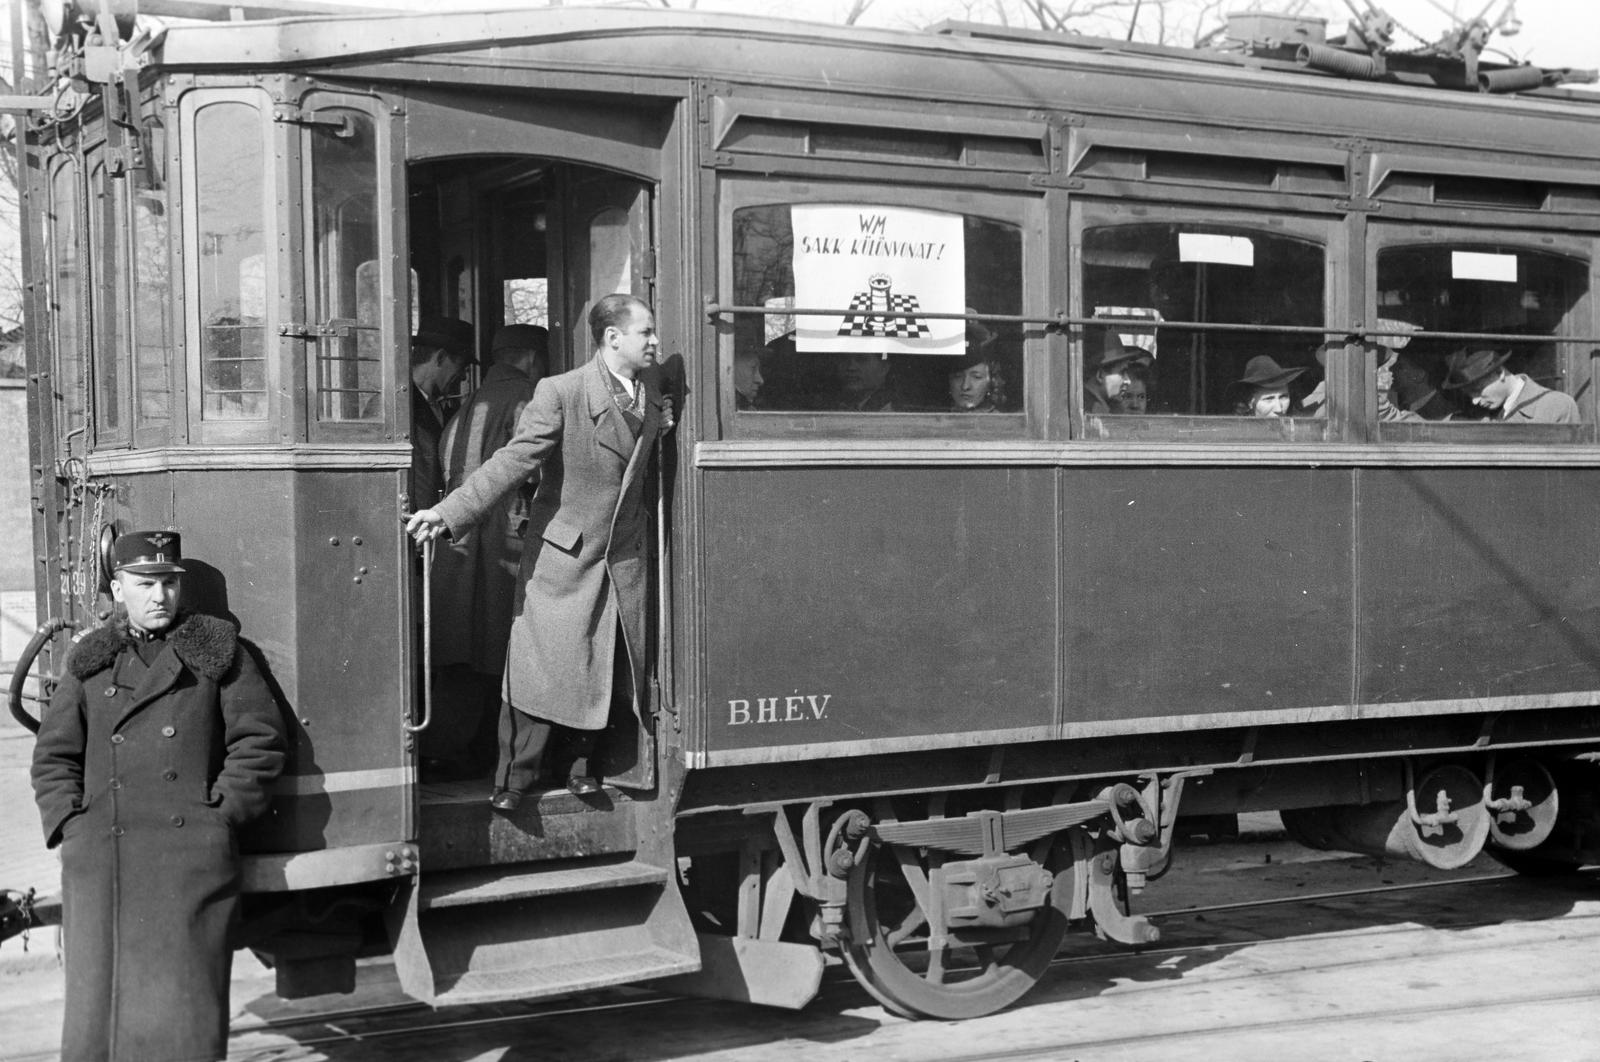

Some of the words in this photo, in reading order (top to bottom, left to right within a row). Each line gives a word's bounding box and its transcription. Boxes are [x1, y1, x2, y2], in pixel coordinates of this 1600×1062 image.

[859, 214, 887, 235] WM
[801, 236, 843, 254] SAKK
[727, 689, 832, 725] B.H.É.V.
